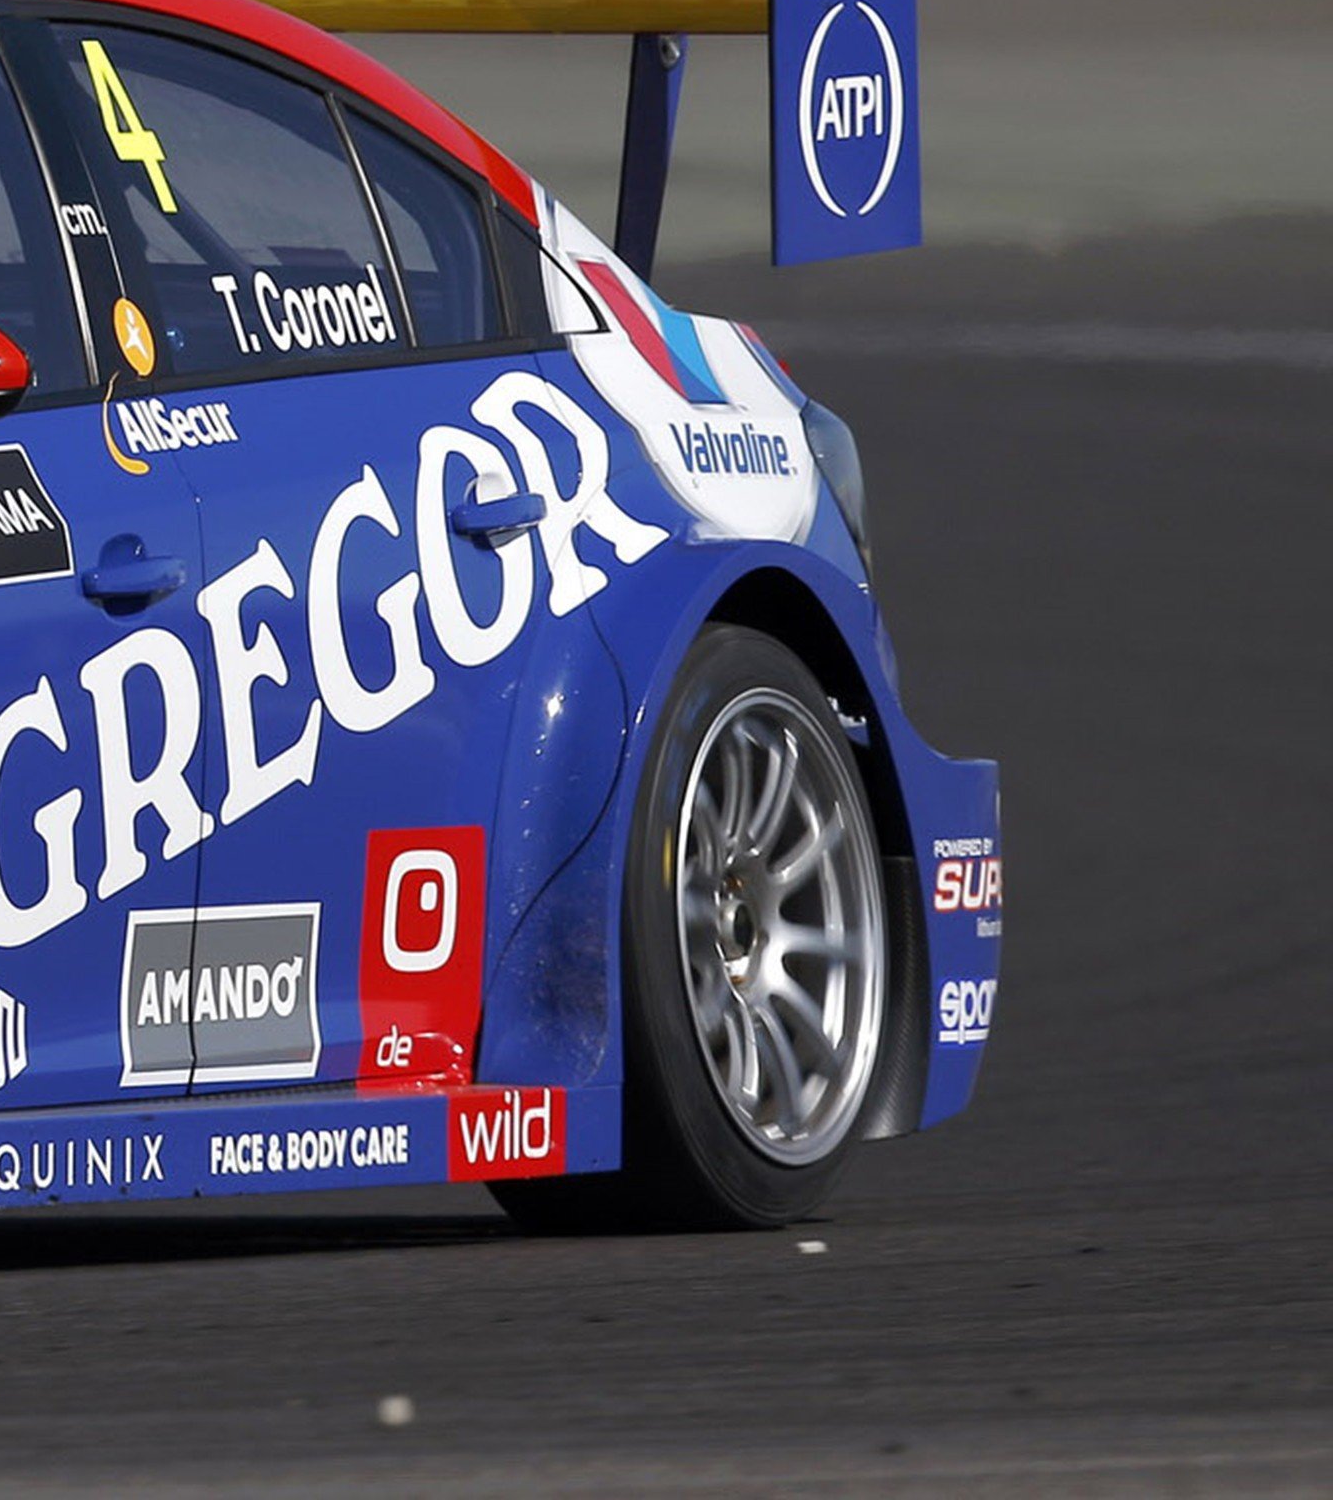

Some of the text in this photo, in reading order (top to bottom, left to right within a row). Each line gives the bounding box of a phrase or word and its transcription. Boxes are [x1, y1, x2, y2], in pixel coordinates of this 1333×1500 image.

[81, 40, 177, 214] 4
[116, 398, 239, 454] AllSecur
[669, 422, 791, 475] Valvoline
[137, 955, 303, 1027] AMANDO
[376, 1024, 413, 1070] de
[211, 1133, 265, 1175] FACE
[287, 1128, 346, 1172] BODY
[350, 1125, 408, 1168] CARE
[461, 1088, 553, 1163] wild
